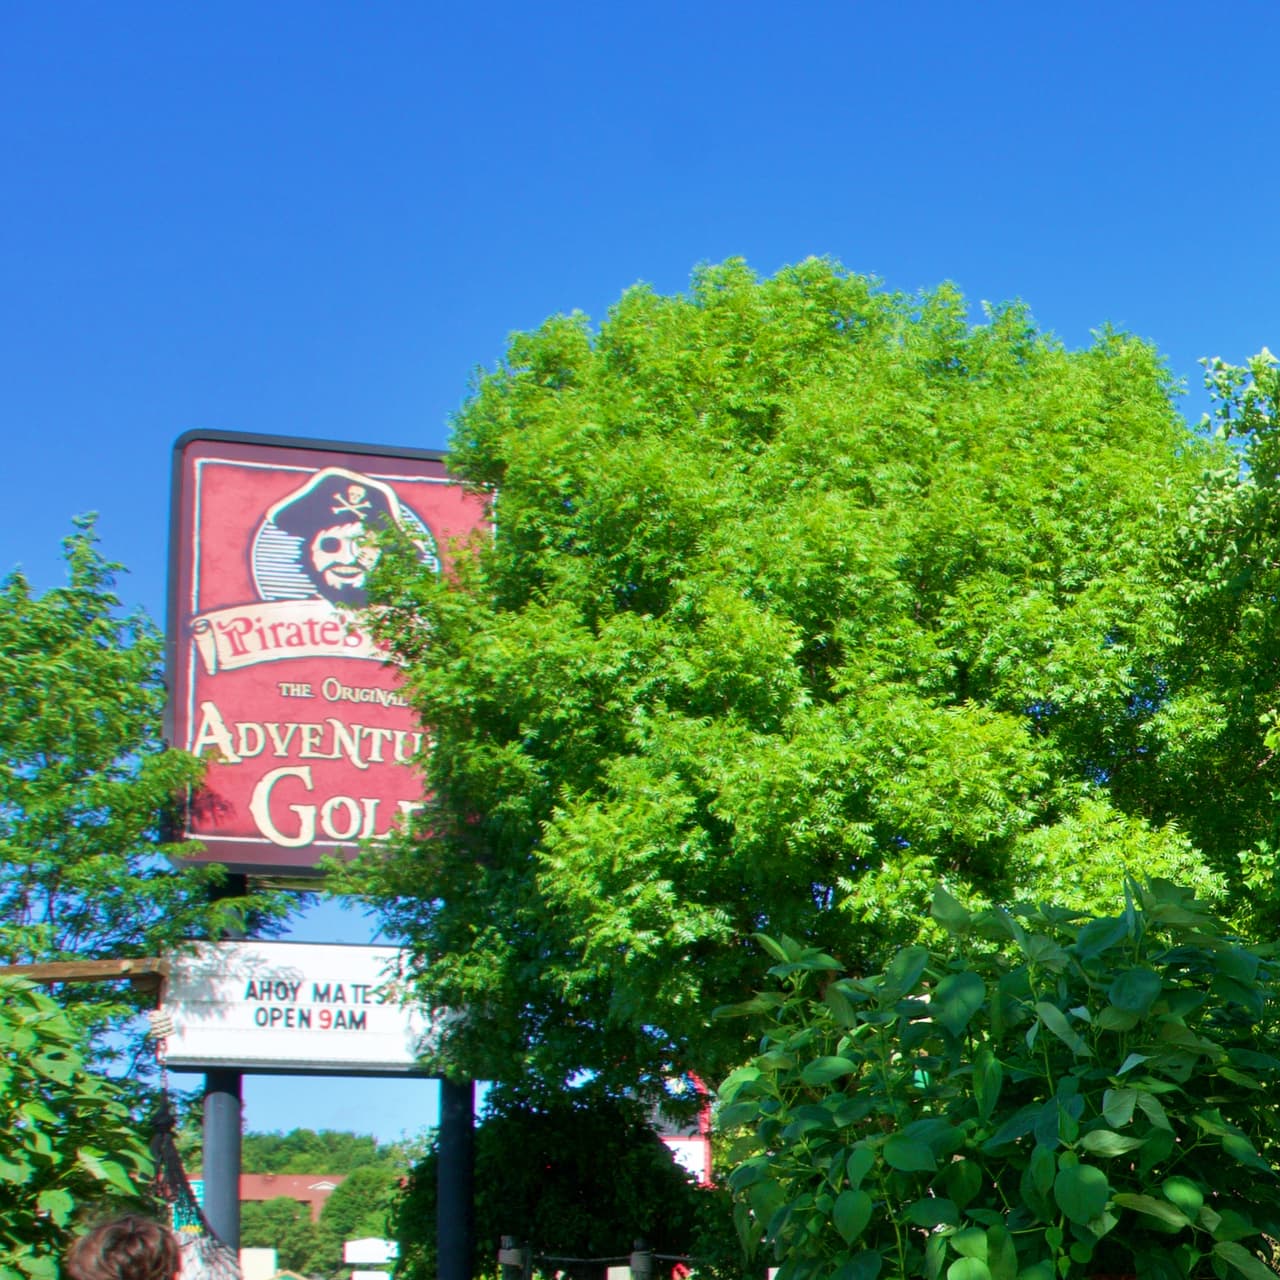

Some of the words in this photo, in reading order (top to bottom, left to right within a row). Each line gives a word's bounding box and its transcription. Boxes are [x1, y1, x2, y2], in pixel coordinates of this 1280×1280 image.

[278, 682, 314, 698] THE
[193, 701, 436, 769] ADVENTU
[245, 980, 302, 1001] AHOY
[255, 1007, 311, 1029] OPEN
[319, 1009, 367, 1031] 9AM
